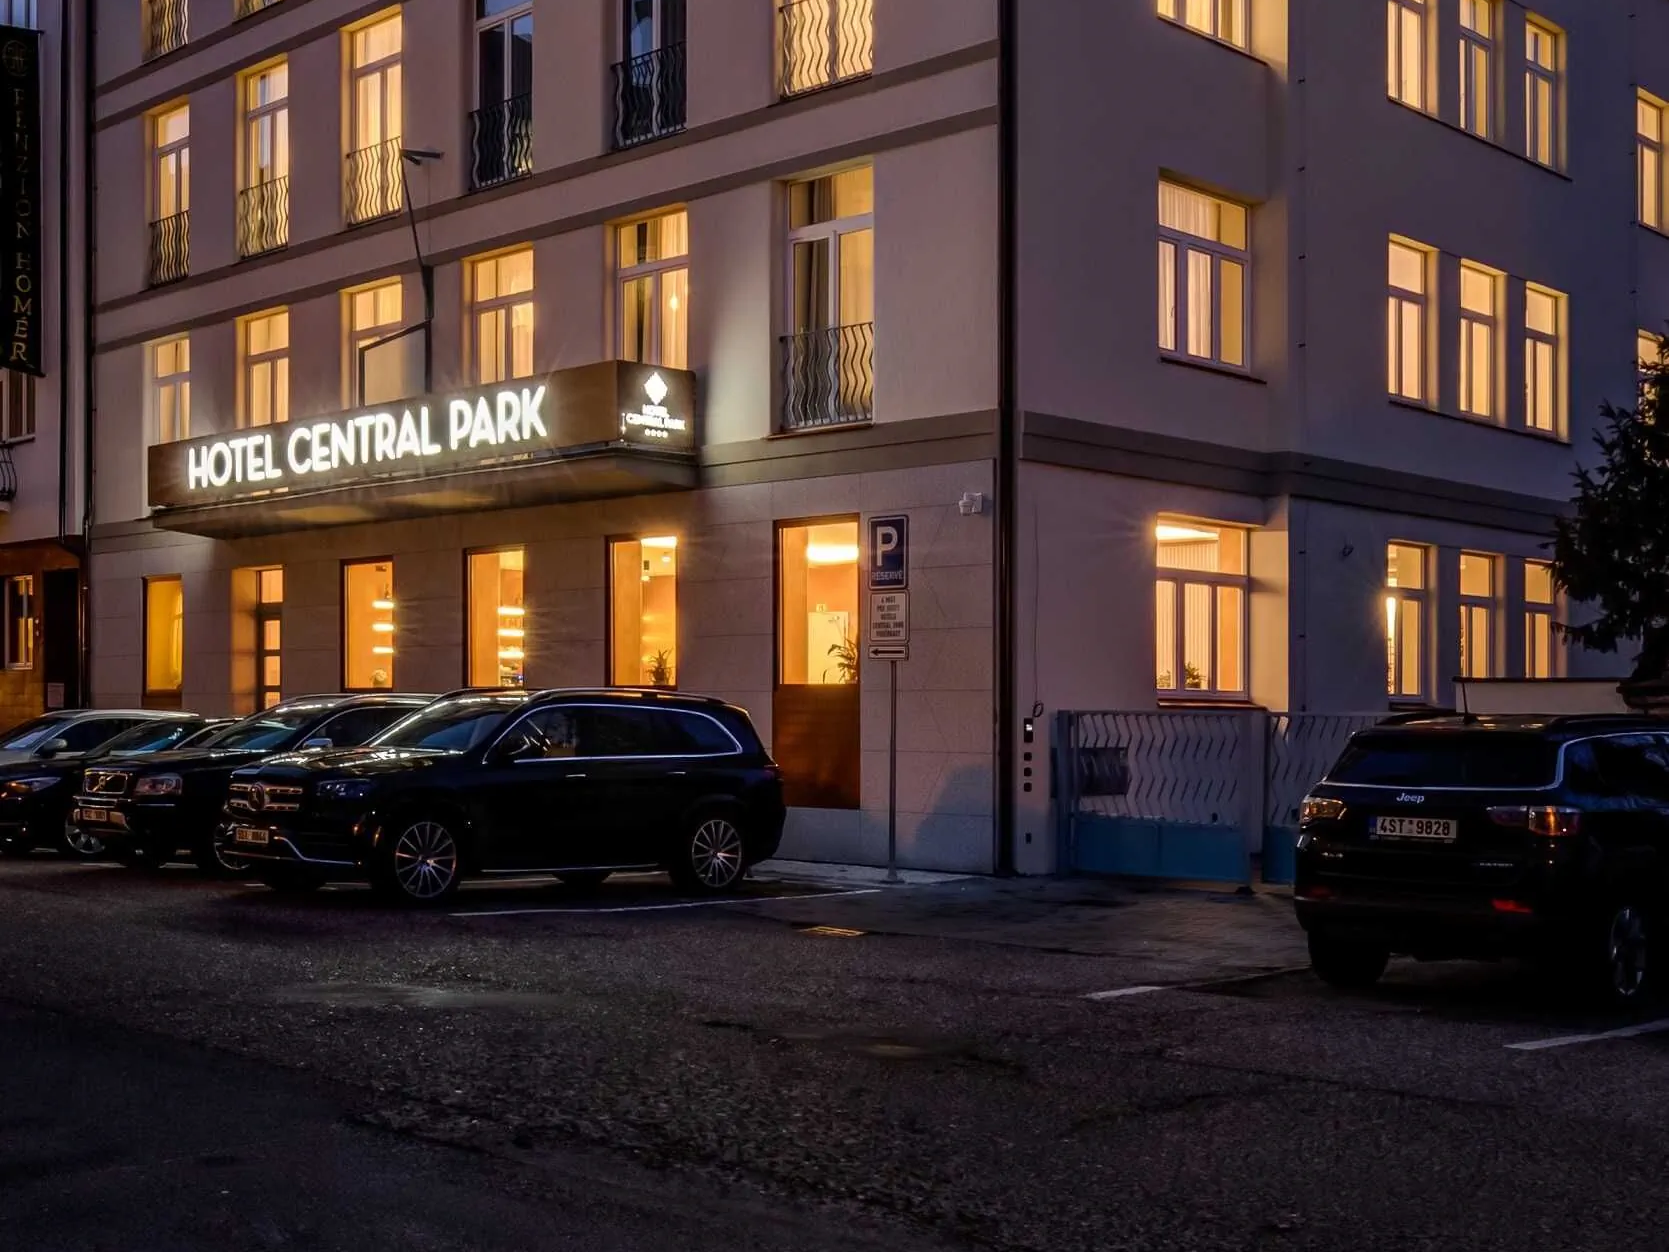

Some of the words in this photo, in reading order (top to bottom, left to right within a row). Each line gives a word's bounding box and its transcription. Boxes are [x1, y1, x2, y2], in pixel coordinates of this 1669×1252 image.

[187, 434, 283, 490] HOTEL
[287, 405, 442, 475] CENTRAL
[448, 385, 548, 450] PARK
[876, 525, 898, 567] P
[1395, 792, 1425, 804] Jeep
[1380, 818, 1406, 834] 4ST
[1415, 820, 1450, 836] 9828
